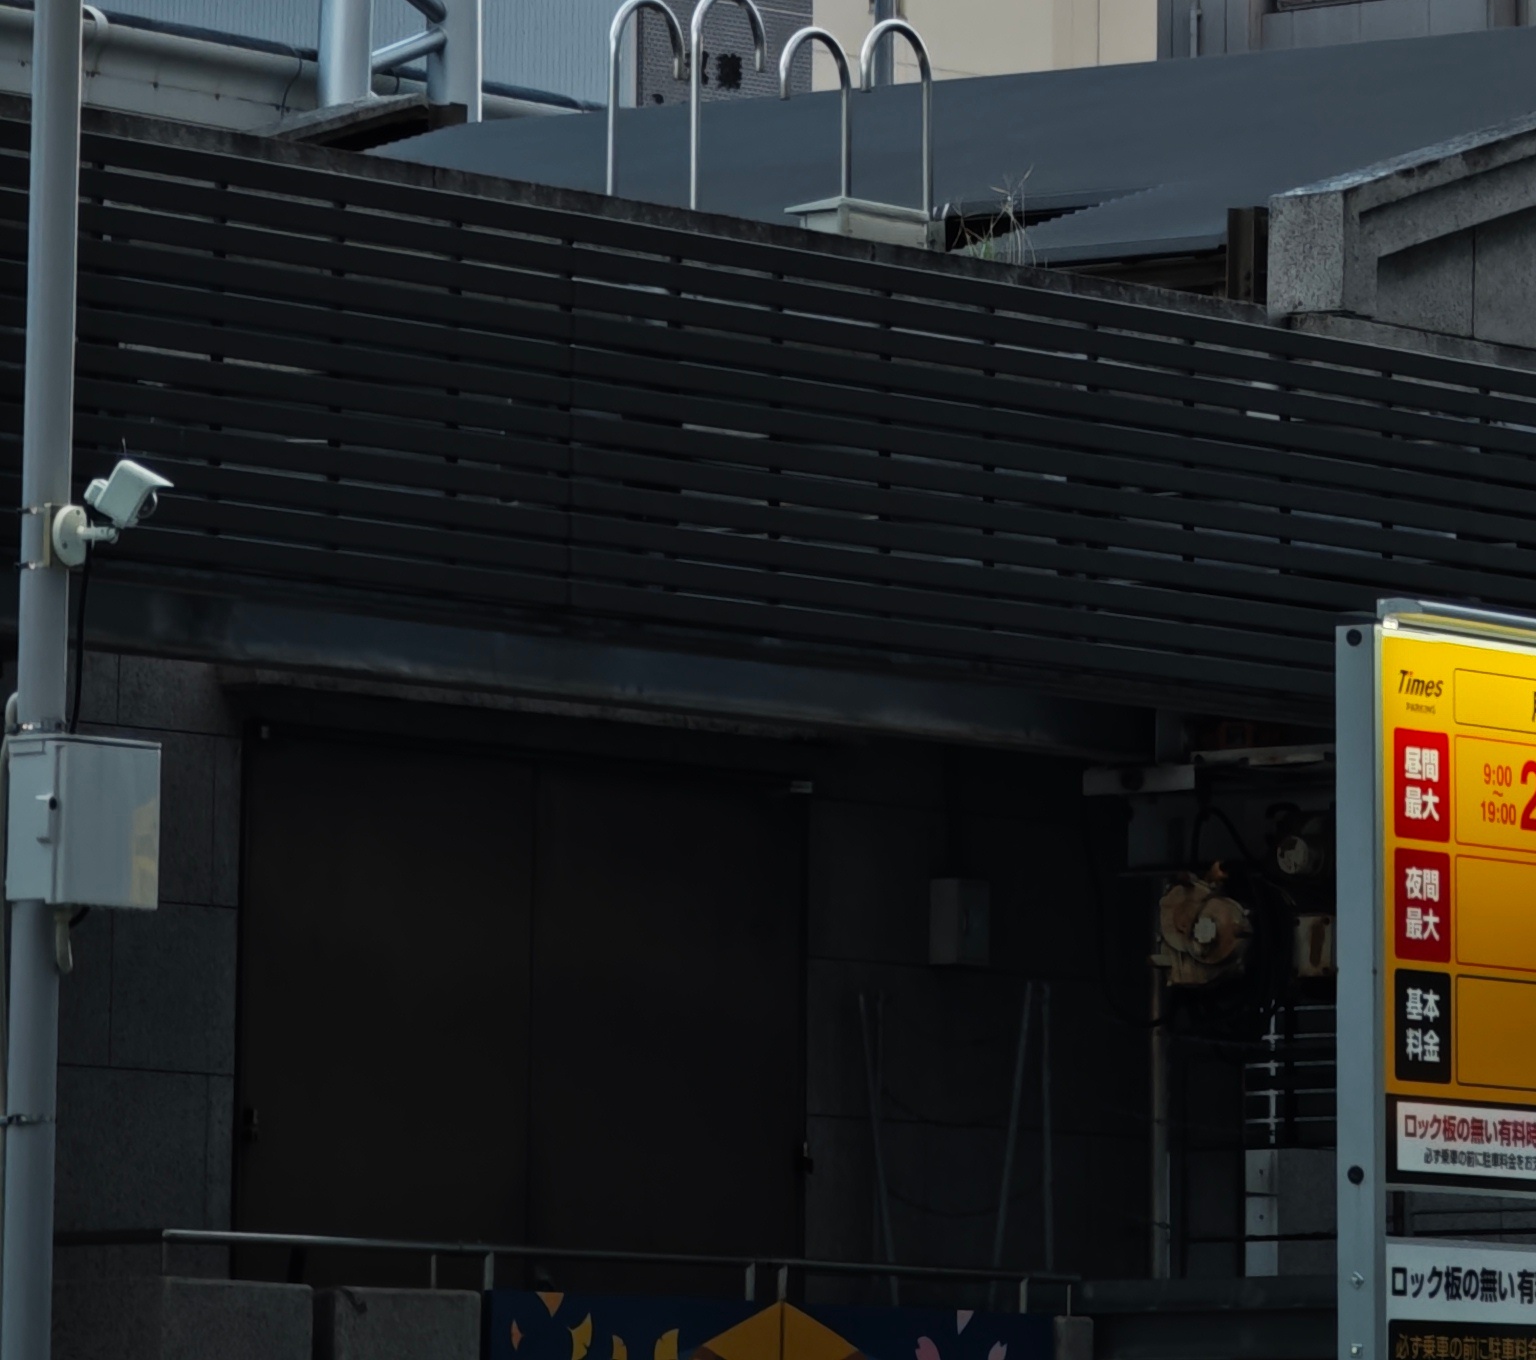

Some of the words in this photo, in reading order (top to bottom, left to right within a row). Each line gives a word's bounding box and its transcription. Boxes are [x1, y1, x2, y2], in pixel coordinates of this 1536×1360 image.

[1398, 669, 1444, 698] Times
[1404, 745, 1440, 783] 昼間
[1483, 762, 1513, 787] 9:00
[1404, 786, 1440, 822] 最大
[1480, 800, 1517, 825] 19:00
[1405, 866, 1440, 902] 夜間
[1405, 907, 1440, 942] 最大
[1405, 988, 1441, 1023] 基本
[1405, 1028, 1441, 1063] 料金
